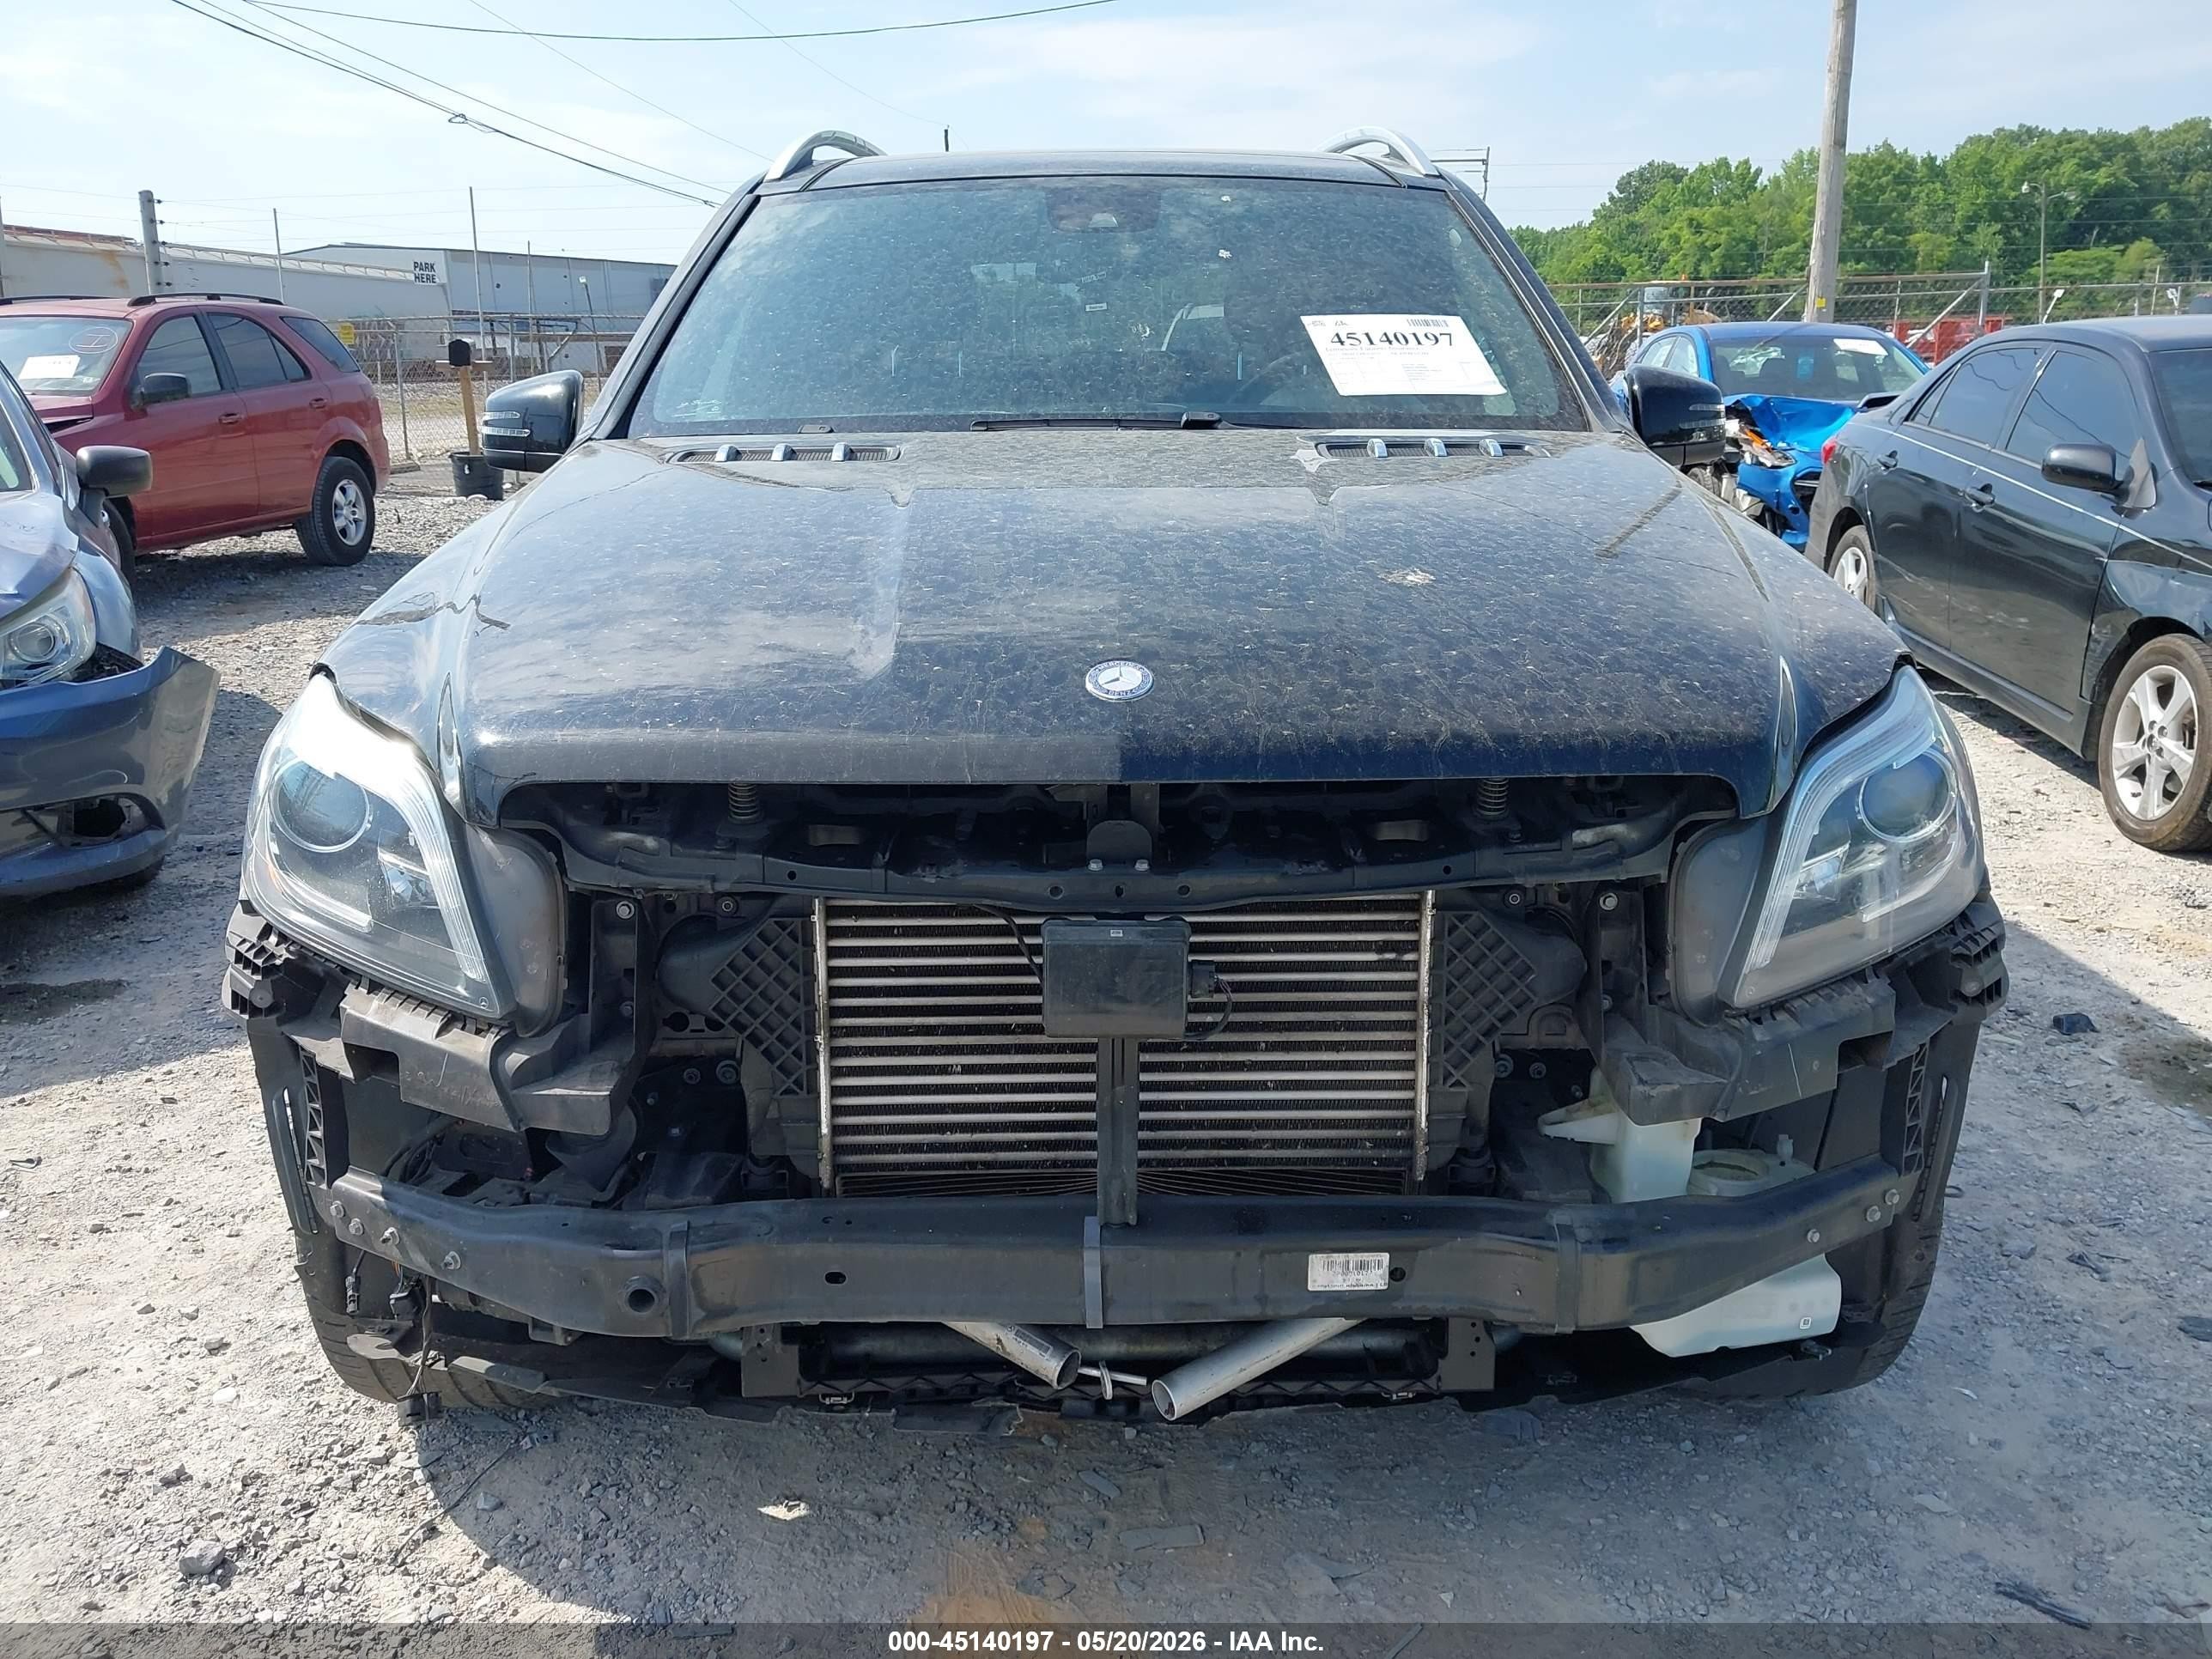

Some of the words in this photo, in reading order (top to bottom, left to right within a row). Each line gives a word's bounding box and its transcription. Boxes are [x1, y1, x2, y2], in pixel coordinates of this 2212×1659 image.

[413, 261, 435, 272] PARK
[414, 272, 437, 283] HERE
[1330, 331, 1452, 346] 45140197
